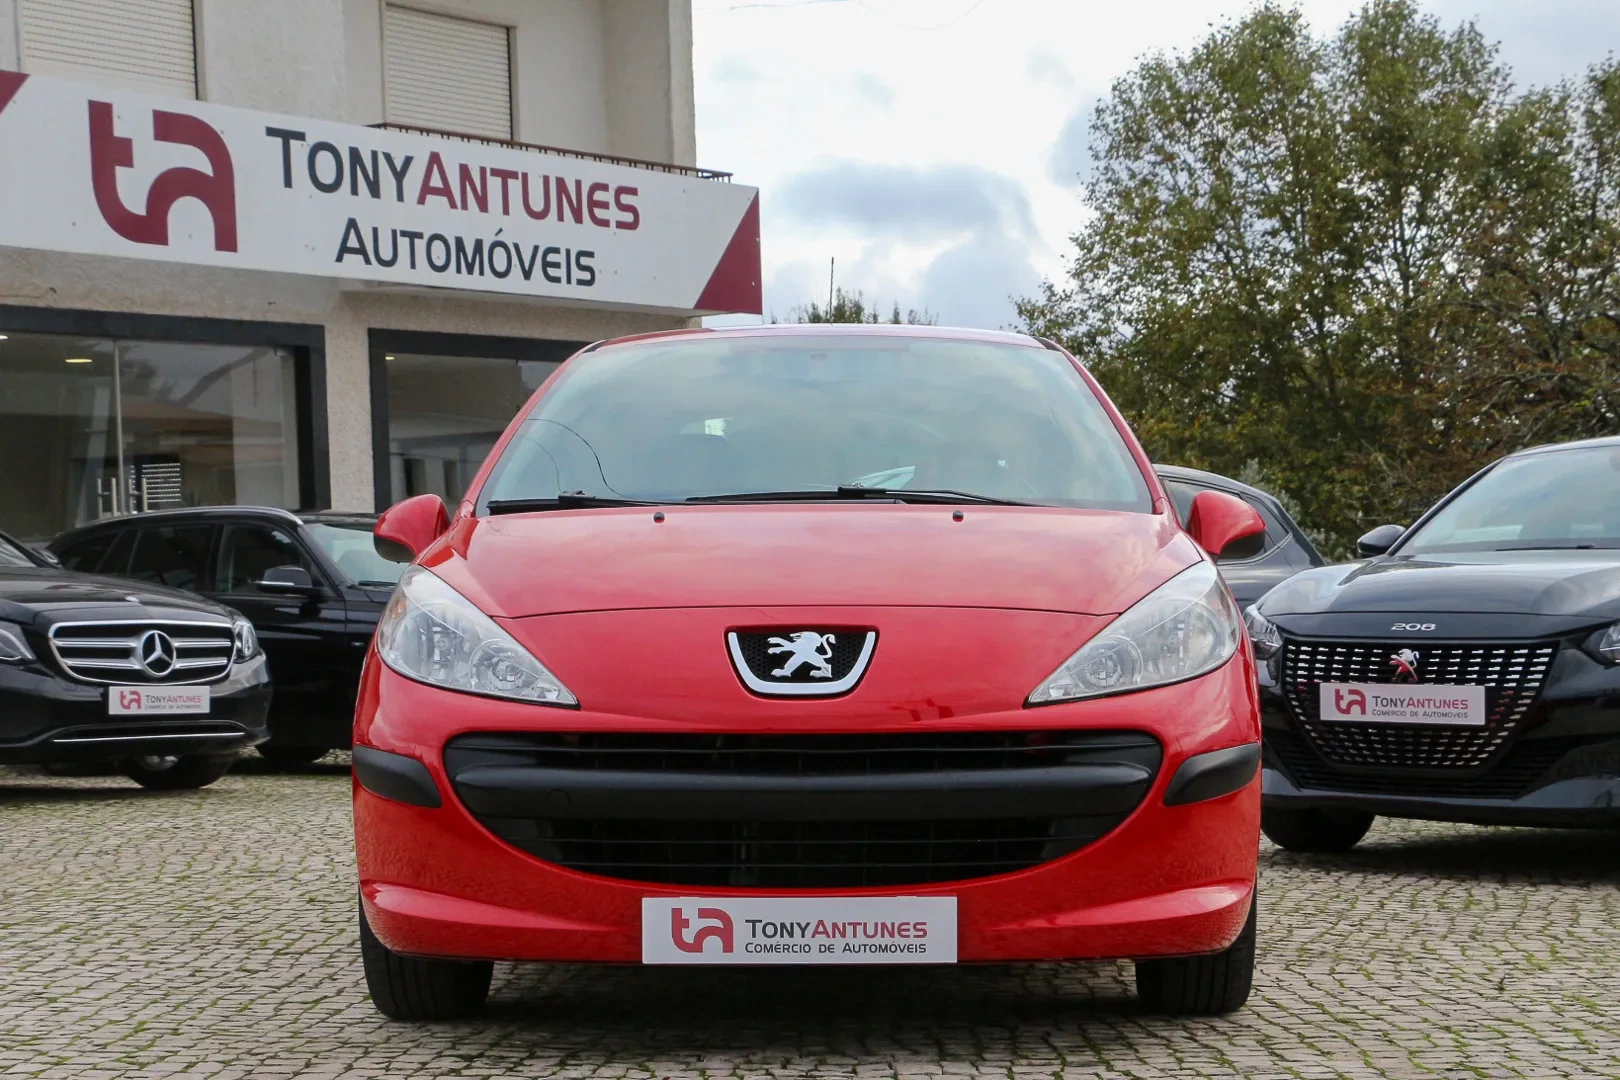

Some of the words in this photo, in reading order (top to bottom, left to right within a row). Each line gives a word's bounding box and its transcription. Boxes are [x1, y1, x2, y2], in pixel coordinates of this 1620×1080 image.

[335, 217, 597, 287] AUTOMÓVEIS
[1391, 622, 1436, 631] 208
[745, 941, 811, 954] COMÉRCIO
[819, 943, 835, 954] DE
[842, 941, 928, 954] AUTOMÓVEIS
